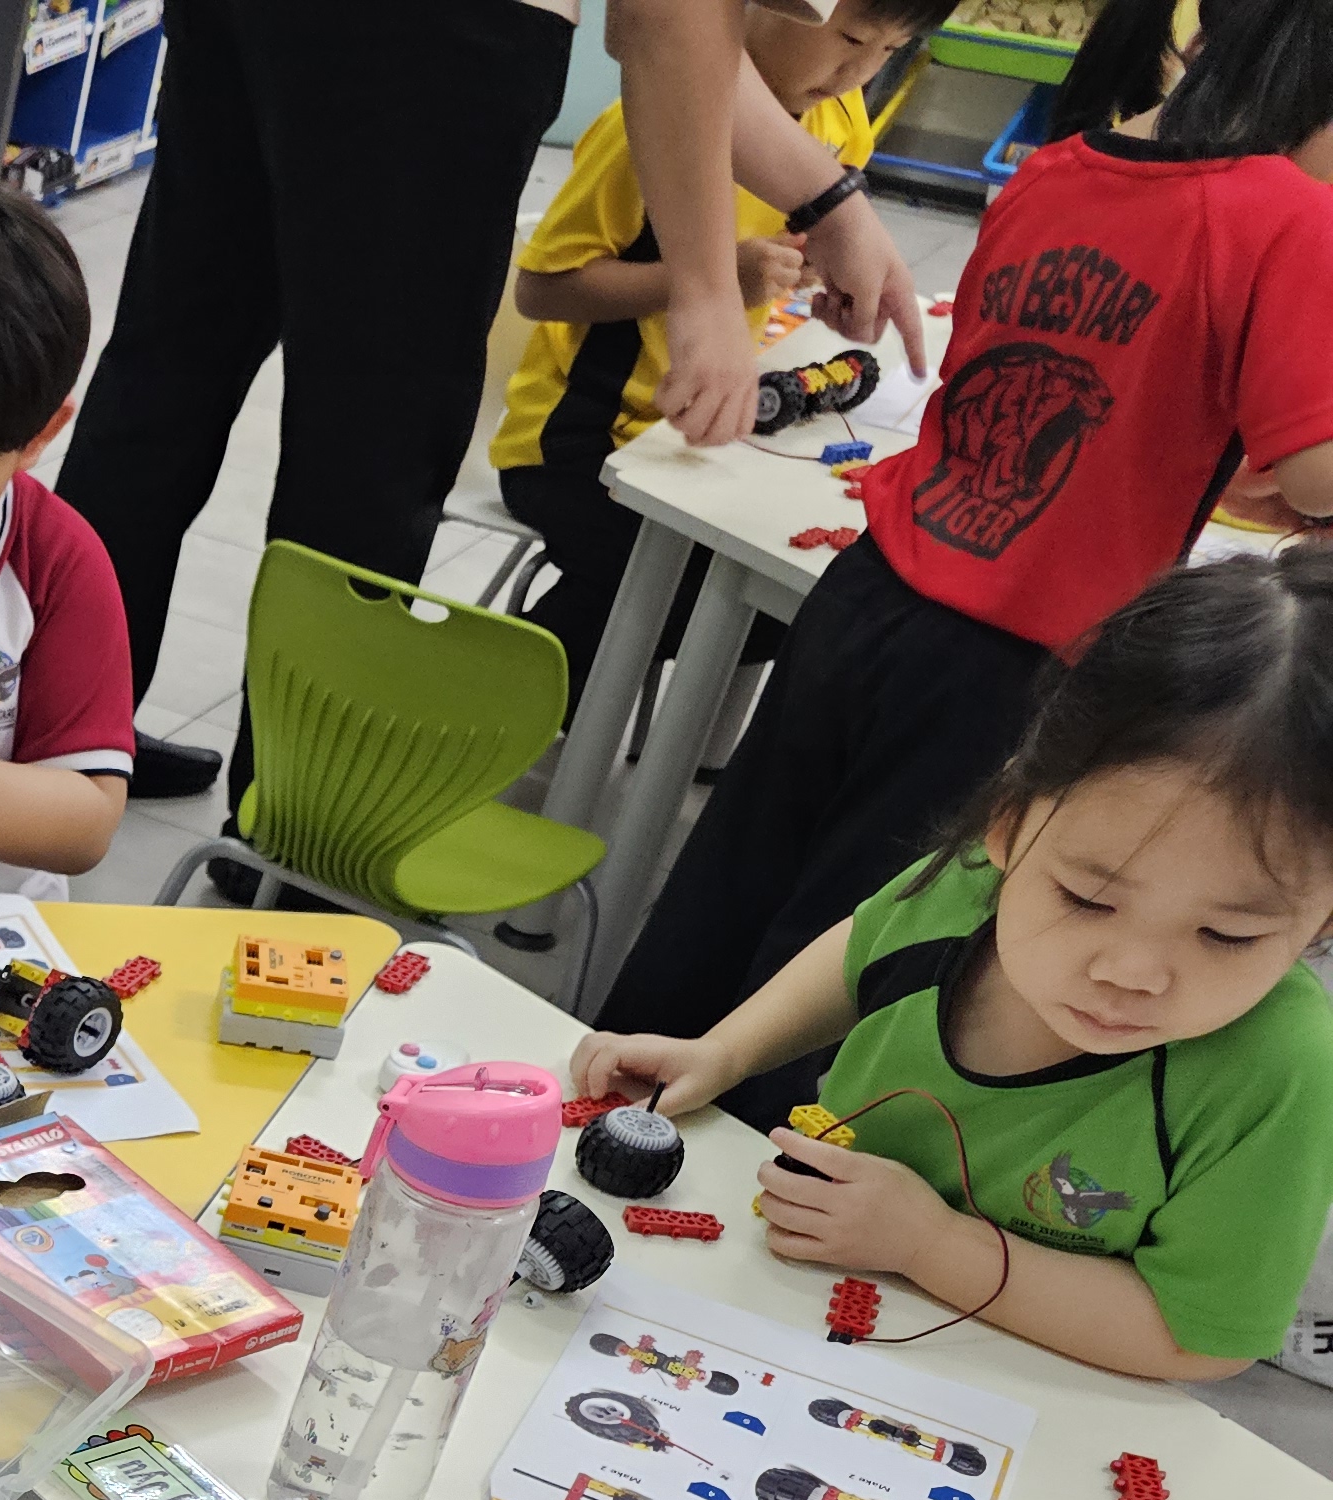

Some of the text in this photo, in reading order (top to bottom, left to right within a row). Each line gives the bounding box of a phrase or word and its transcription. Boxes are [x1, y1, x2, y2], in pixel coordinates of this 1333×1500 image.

[979, 245, 1162, 345] SRI BESTARI
[913, 463, 1017, 550] TIGER
[610, 1468, 642, 1485] Make
[859, 1477, 891, 1493] Make
